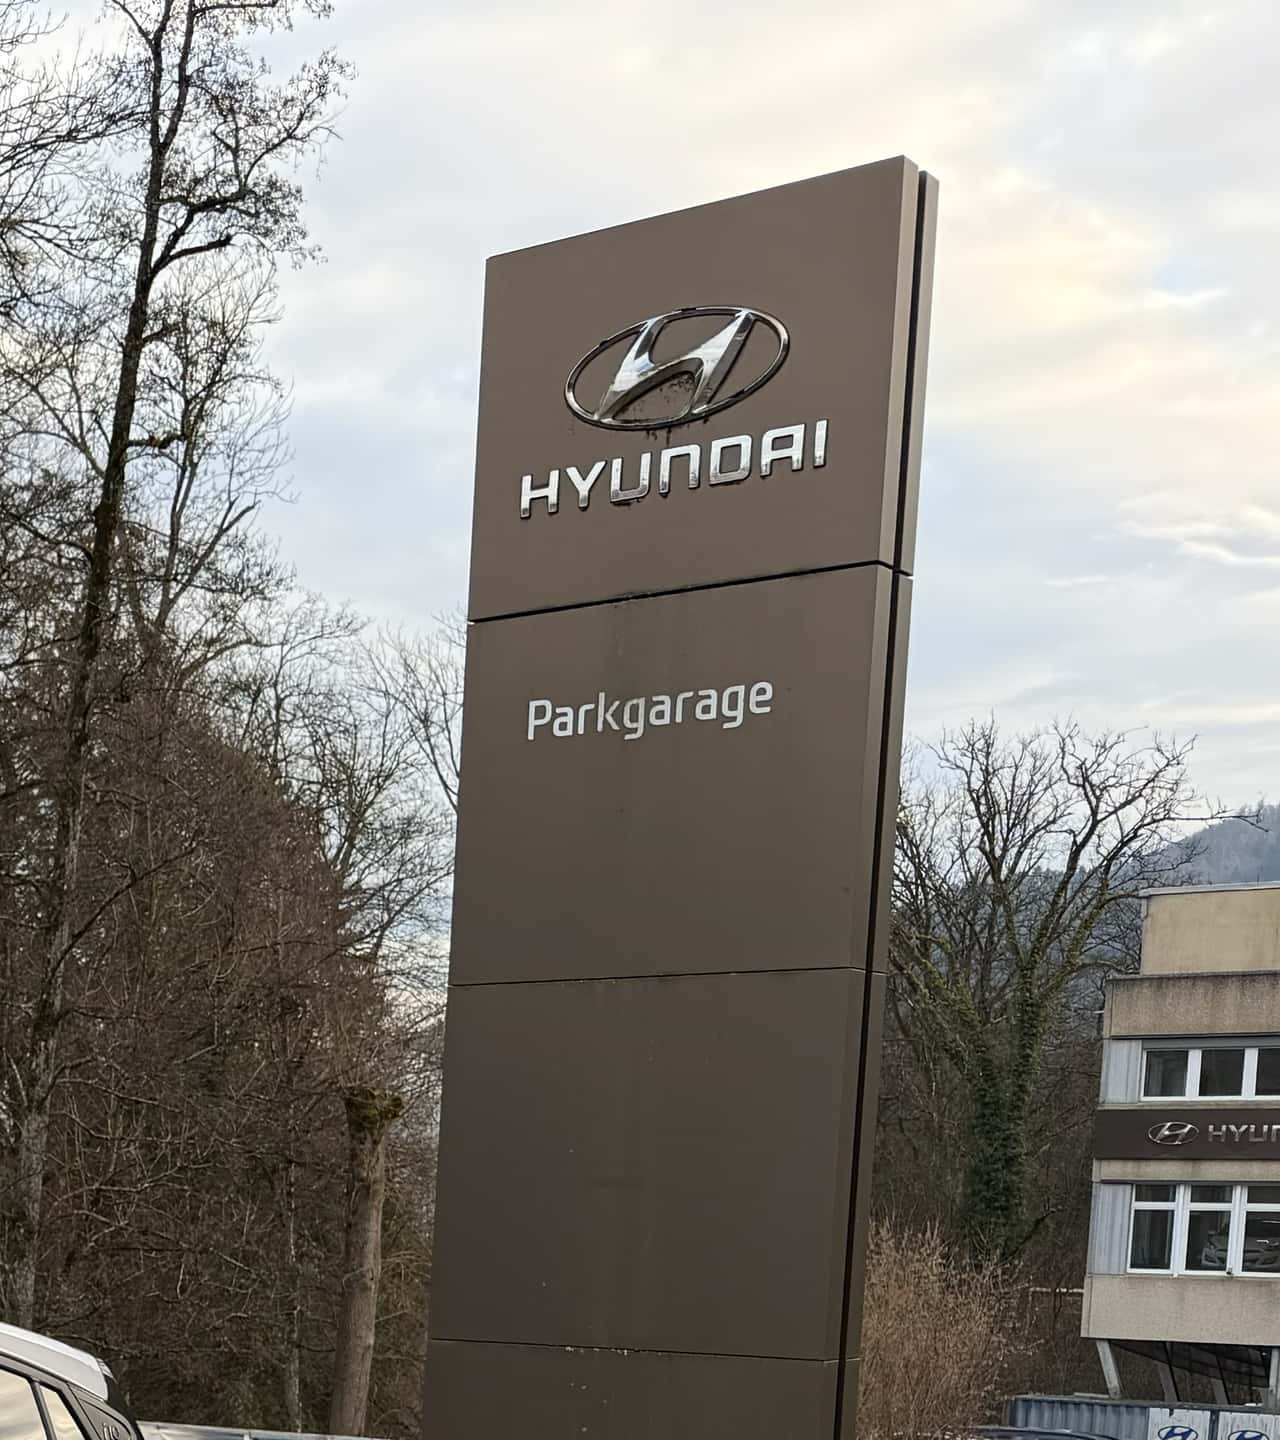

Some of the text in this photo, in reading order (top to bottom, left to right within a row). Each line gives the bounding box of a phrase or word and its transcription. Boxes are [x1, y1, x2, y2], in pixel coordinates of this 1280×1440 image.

[520, 419, 829, 519] HYUNDAI
[527, 681, 774, 741] Parkgarage
[102, 1422, 120, 1440] i10
